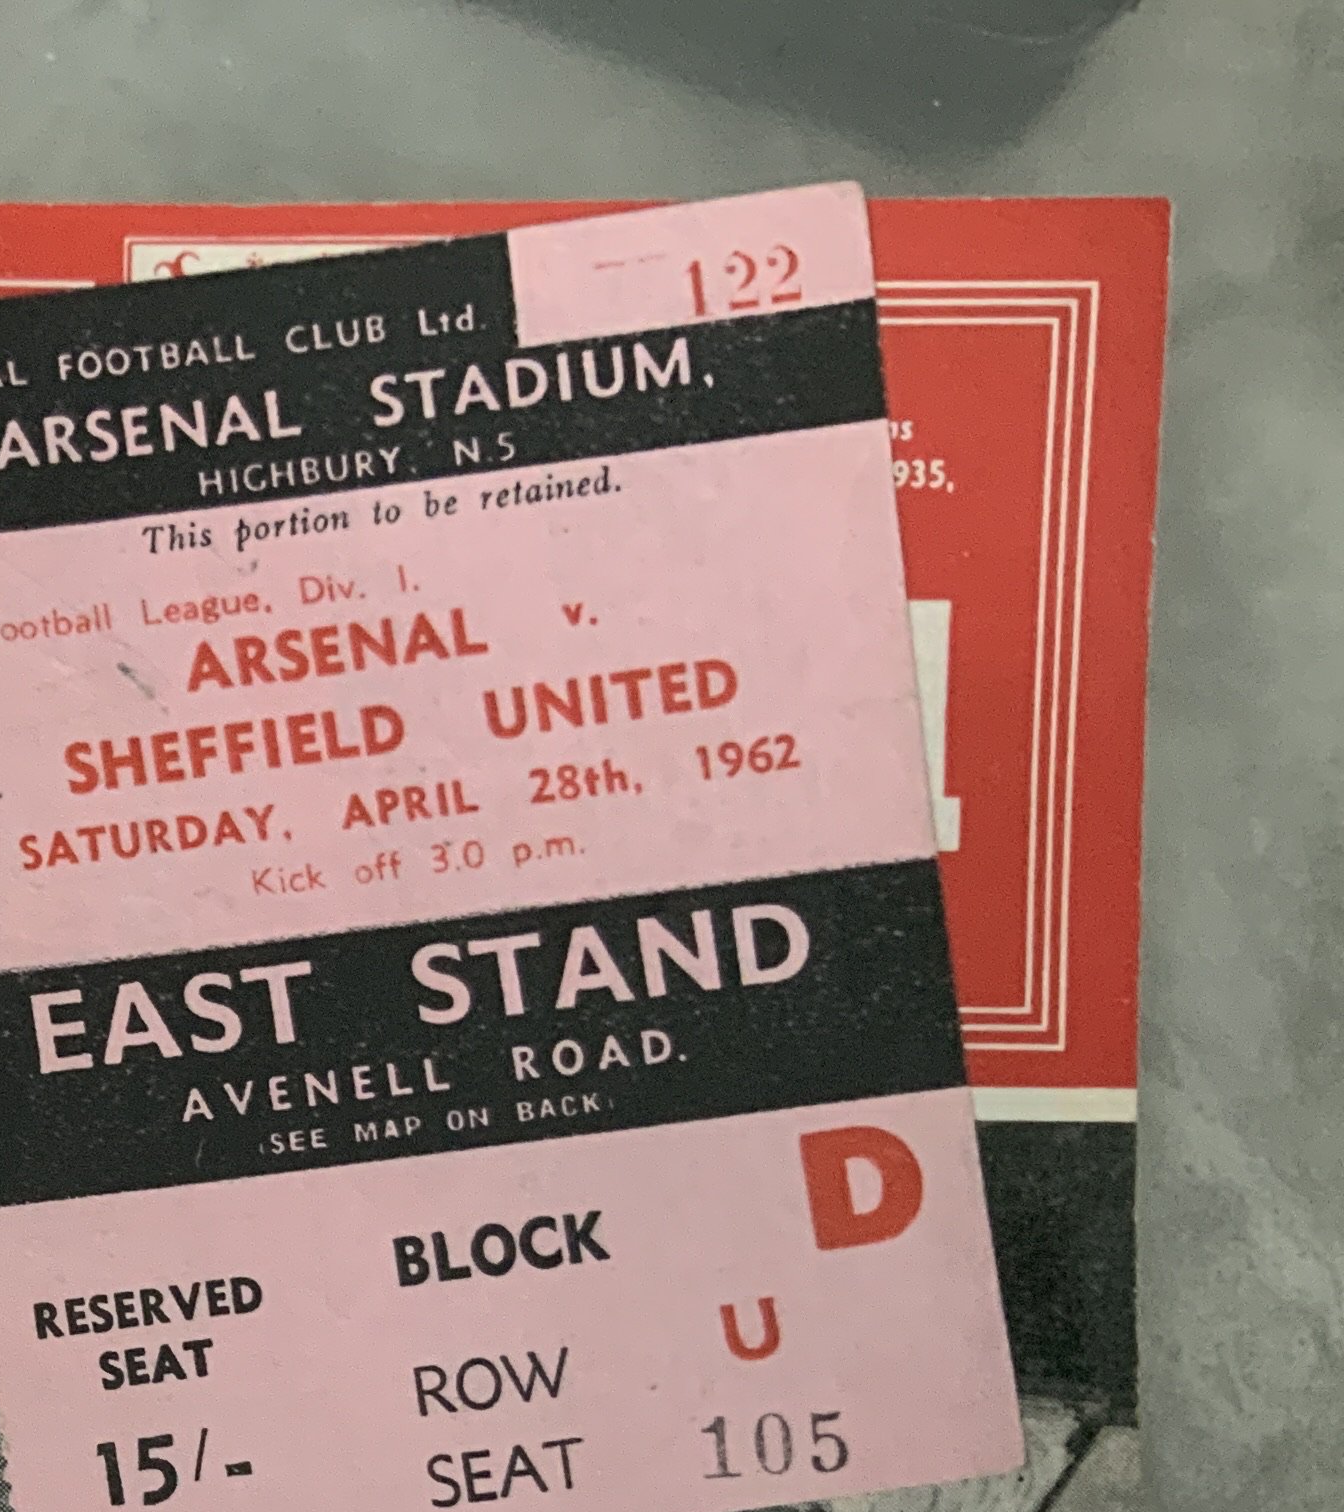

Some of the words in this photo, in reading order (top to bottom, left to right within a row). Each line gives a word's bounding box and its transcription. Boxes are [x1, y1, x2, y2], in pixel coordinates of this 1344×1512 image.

[685, 243, 803, 317] 122
[57, 333, 256, 382] FOOTBALL
[285, 316, 387, 354] CLUB
[143, 523, 213, 555] This
[235, 506, 351, 552] portion
[373, 498, 401, 526] to
[424, 487, 458, 519] be
[480, 467, 623, 510] retained.
[892, 458, 954, 494] 935,
[299, 573, 366, 605] Div.
[187, 607, 489, 692] ARSENAL
[562, 602, 598, 628] v.
[64, 704, 405, 794] SHEFFIELD
[484, 658, 739, 740] UNITED
[341, 780, 480, 830] APRIL
[529, 758, 644, 804] 28th,
[695, 734, 802, 780] 1962
[251, 865, 324, 895] Kick
[354, 851, 402, 885] off
[431, 841, 486, 873] 3.0
[512, 835, 586, 868] p.m.
[30, 961, 312, 1074] EAST
[412, 903, 810, 1024] STAND
[182, 1058, 451, 1122] AVENELL
[512, 1030, 688, 1081] ROAD.
[269, 1129, 328, 1154] SEE
[355, 1116, 421, 1143] MAP
[447, 1108, 490, 1132] ON
[517, 1096, 601, 1124] BACK
[393, 1210, 610, 1287] BLOCK
[799, 1125, 924, 1252] D
[34, 1276, 264, 1340] RESERVED
[98, 1338, 213, 1391] SEAT
[413, 1346, 569, 1417] ROW
[720, 1296, 781, 1361] U
[95, 1427, 253, 1507] 15/-
[426, 1436, 584, 1508] SEAT
[700, 1410, 850, 1480] 105
